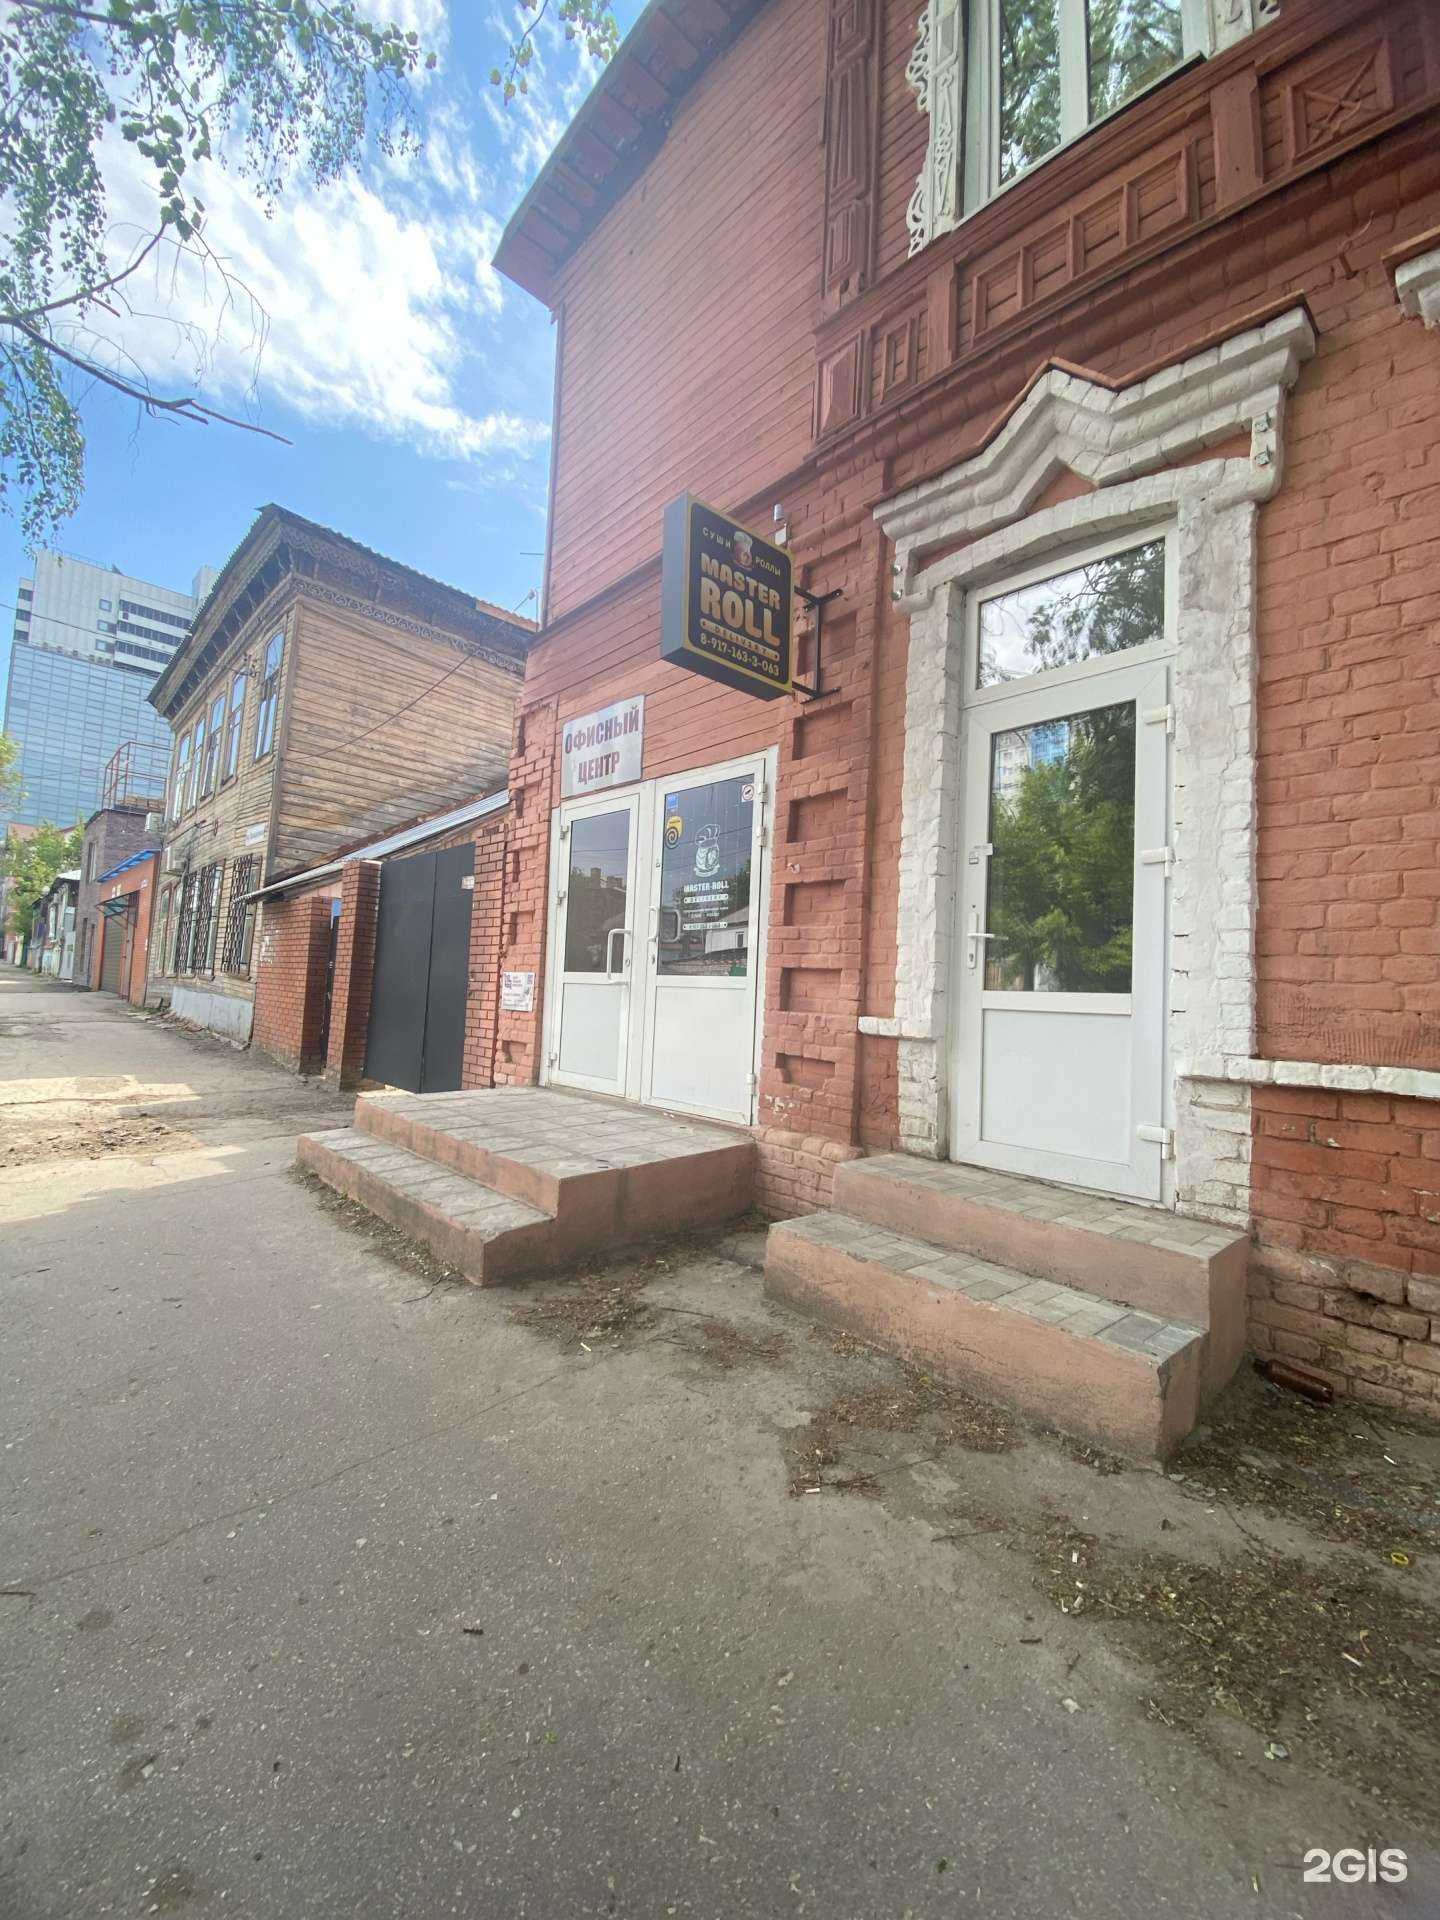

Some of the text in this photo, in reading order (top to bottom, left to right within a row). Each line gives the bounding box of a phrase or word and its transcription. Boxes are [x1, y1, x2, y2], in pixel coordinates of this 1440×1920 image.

[702, 526, 781, 576] СУШИ РОЛЛЫ
[700, 552, 781, 610] MASTER
[700, 576, 781, 647] ROLL
[700, 632, 780, 677] 8-917-163-3-063
[564, 704, 640, 754] ОФИСНЫЙ
[577, 751, 620, 785] ЦЕНТР
